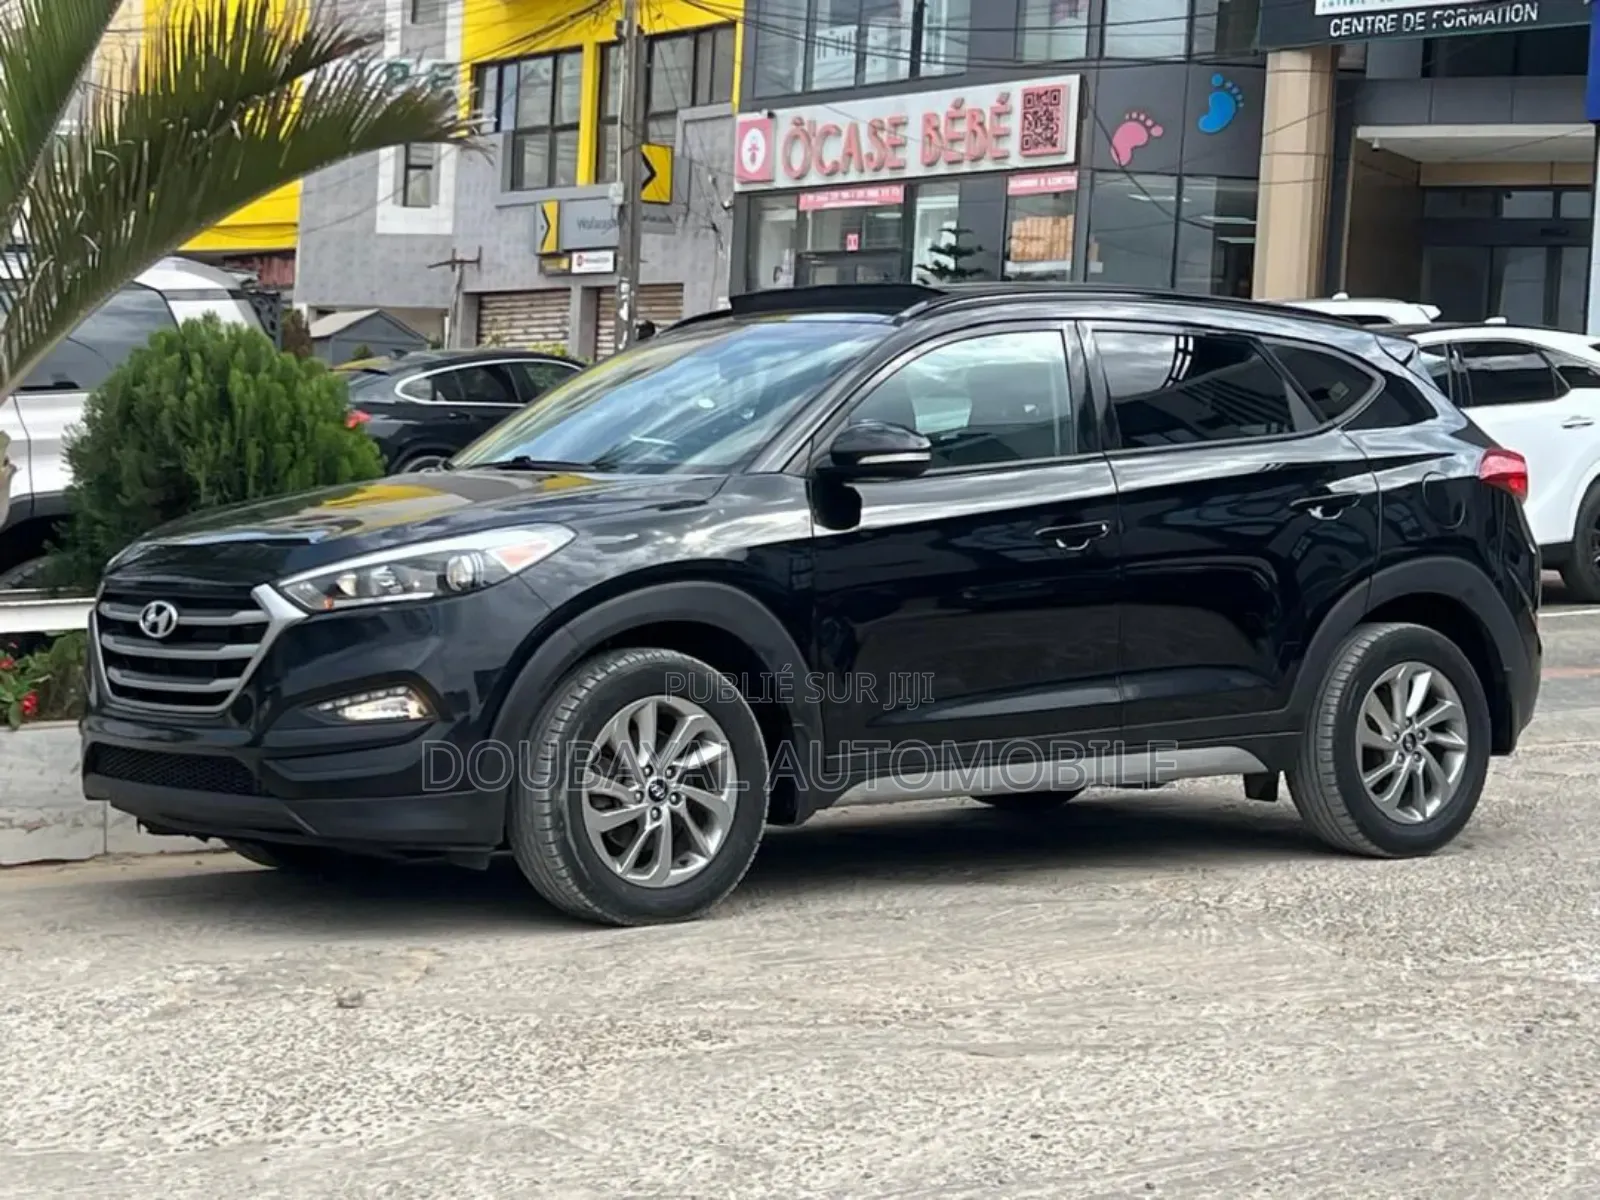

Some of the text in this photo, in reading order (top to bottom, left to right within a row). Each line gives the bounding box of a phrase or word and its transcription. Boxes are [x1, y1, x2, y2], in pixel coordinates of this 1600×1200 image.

[1329, 2, 1538, 37] CENTRE DE FORMATION
[920, 91, 1013, 167] BÉBÉ
